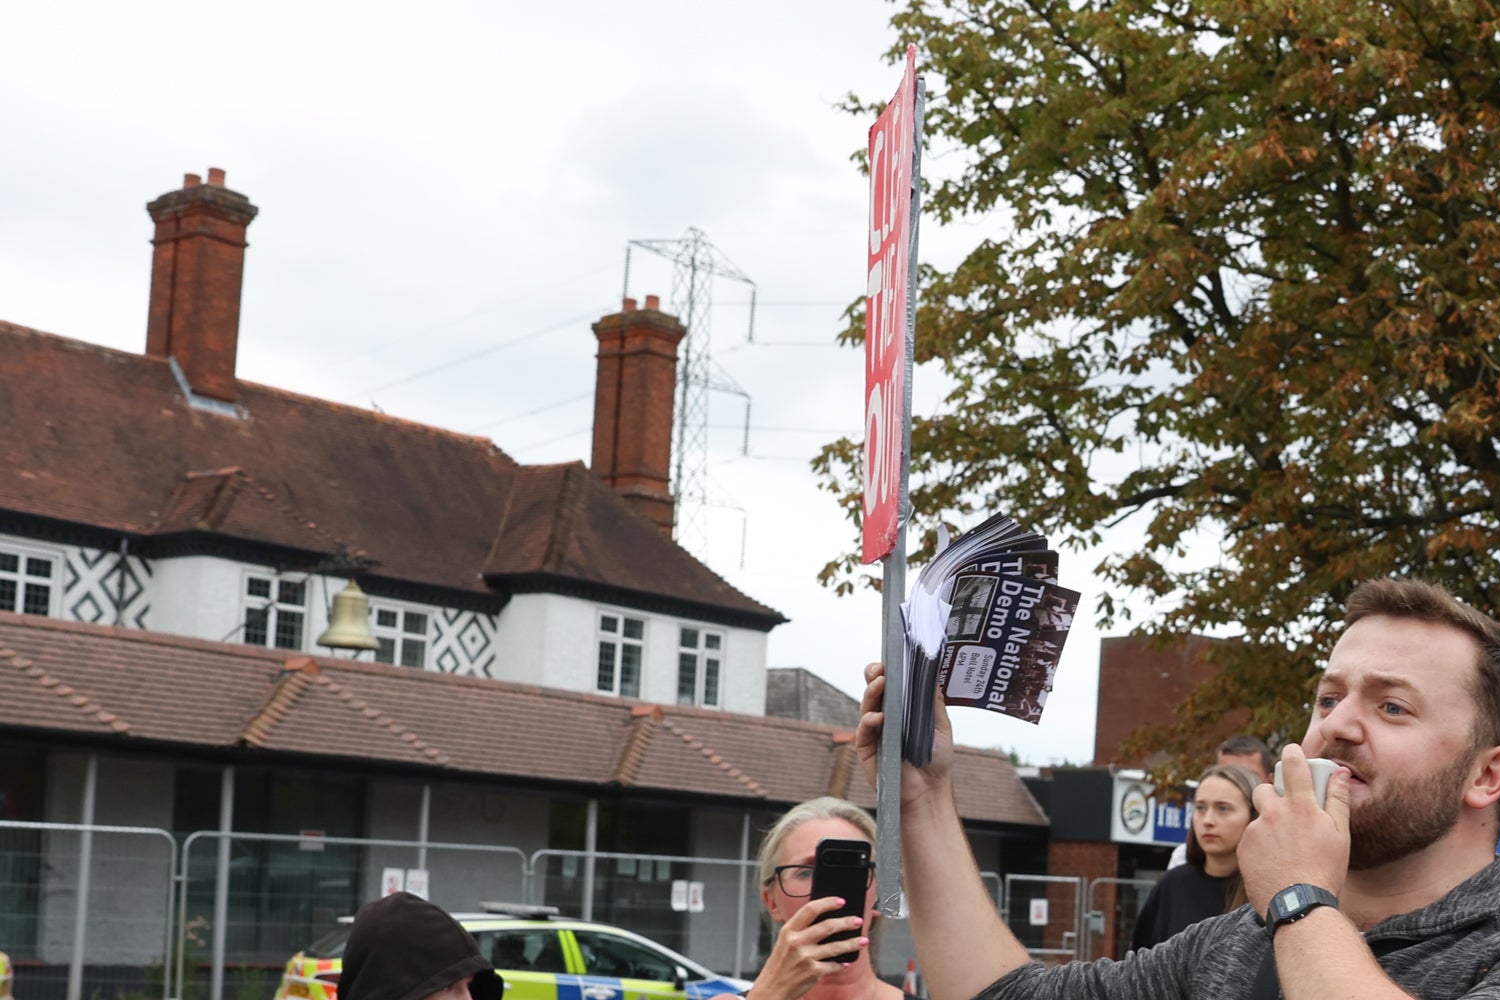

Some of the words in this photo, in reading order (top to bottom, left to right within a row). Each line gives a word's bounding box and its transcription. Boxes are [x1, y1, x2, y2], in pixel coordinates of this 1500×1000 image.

[864, 355, 898, 516] OUT
[987, 580, 1023, 639] Demo
[1015, 585, 1045, 621] The
[942, 645, 955, 669] EPPING
[969, 652, 980, 666] Bell
[976, 654, 993, 679] Sunday
[986, 626, 1031, 711] National
[963, 666, 976, 684] Hotel
[973, 679, 986, 694] 24th
